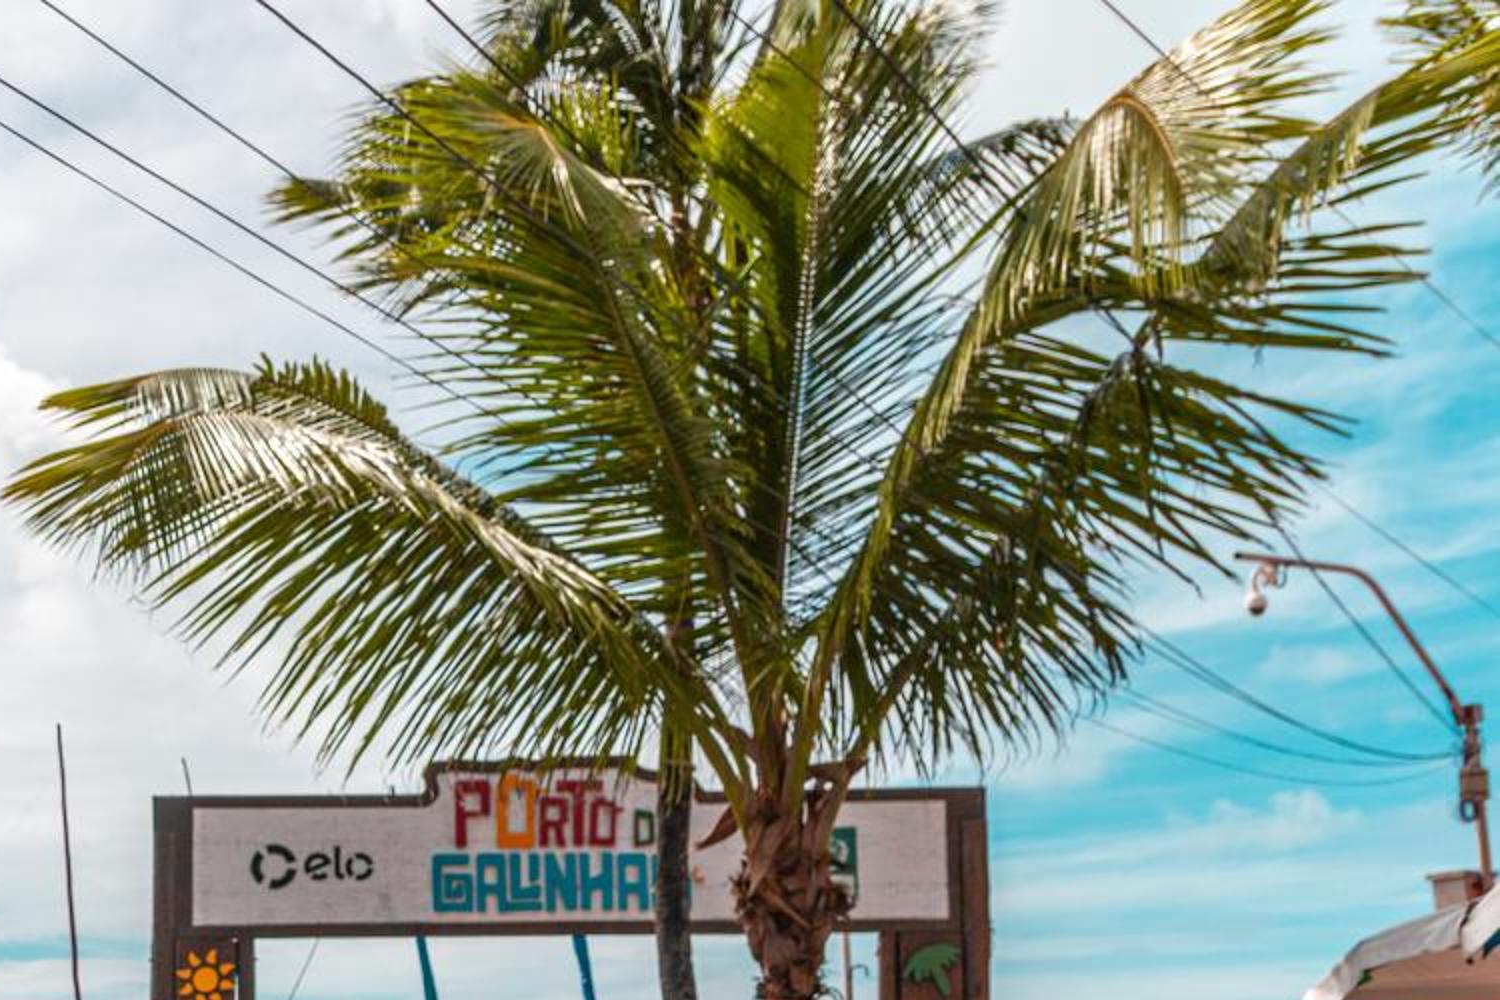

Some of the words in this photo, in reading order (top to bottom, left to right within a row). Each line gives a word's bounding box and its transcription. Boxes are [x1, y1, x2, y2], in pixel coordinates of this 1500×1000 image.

[454, 773, 624, 849] PORTO
[633, 808, 657, 847] D
[303, 845, 374, 881] elo
[432, 852, 662, 913] GALINHA
